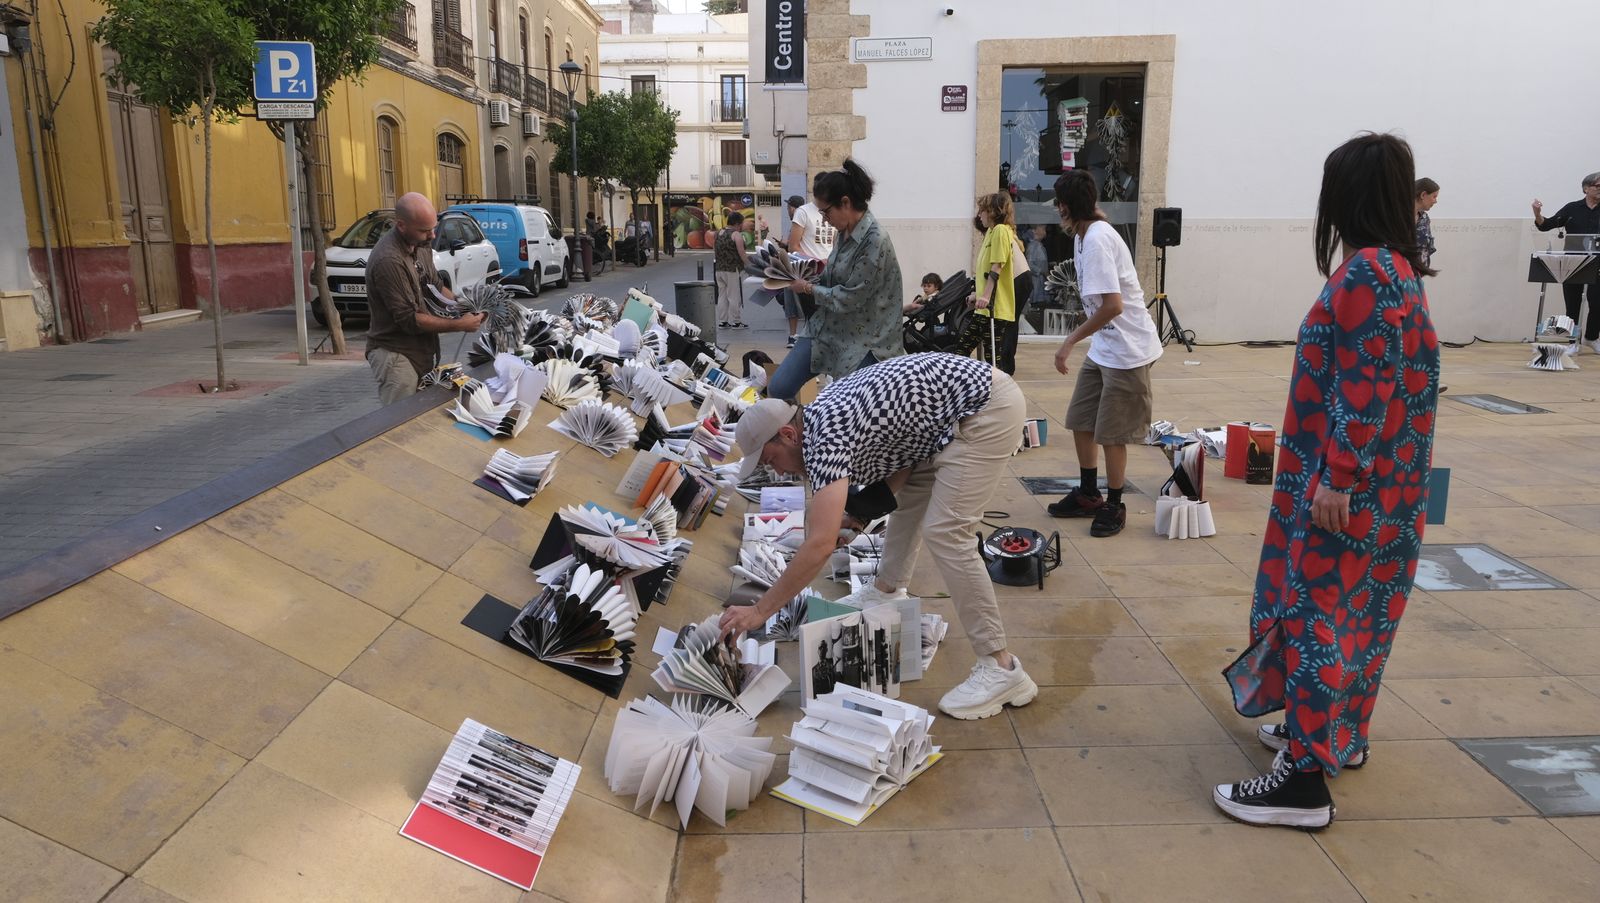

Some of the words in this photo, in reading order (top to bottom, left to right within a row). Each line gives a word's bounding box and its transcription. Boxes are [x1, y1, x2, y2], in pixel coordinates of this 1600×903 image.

[774, 1, 792, 70] Centro
[857, 49, 882, 57] MANUEL
[885, 48, 909, 57] FALCES
[909, 47, 930, 56] LÓPEZ
[269, 50, 300, 93] P
[287, 79, 307, 93] Z1
[477, 221, 508, 230] oris
